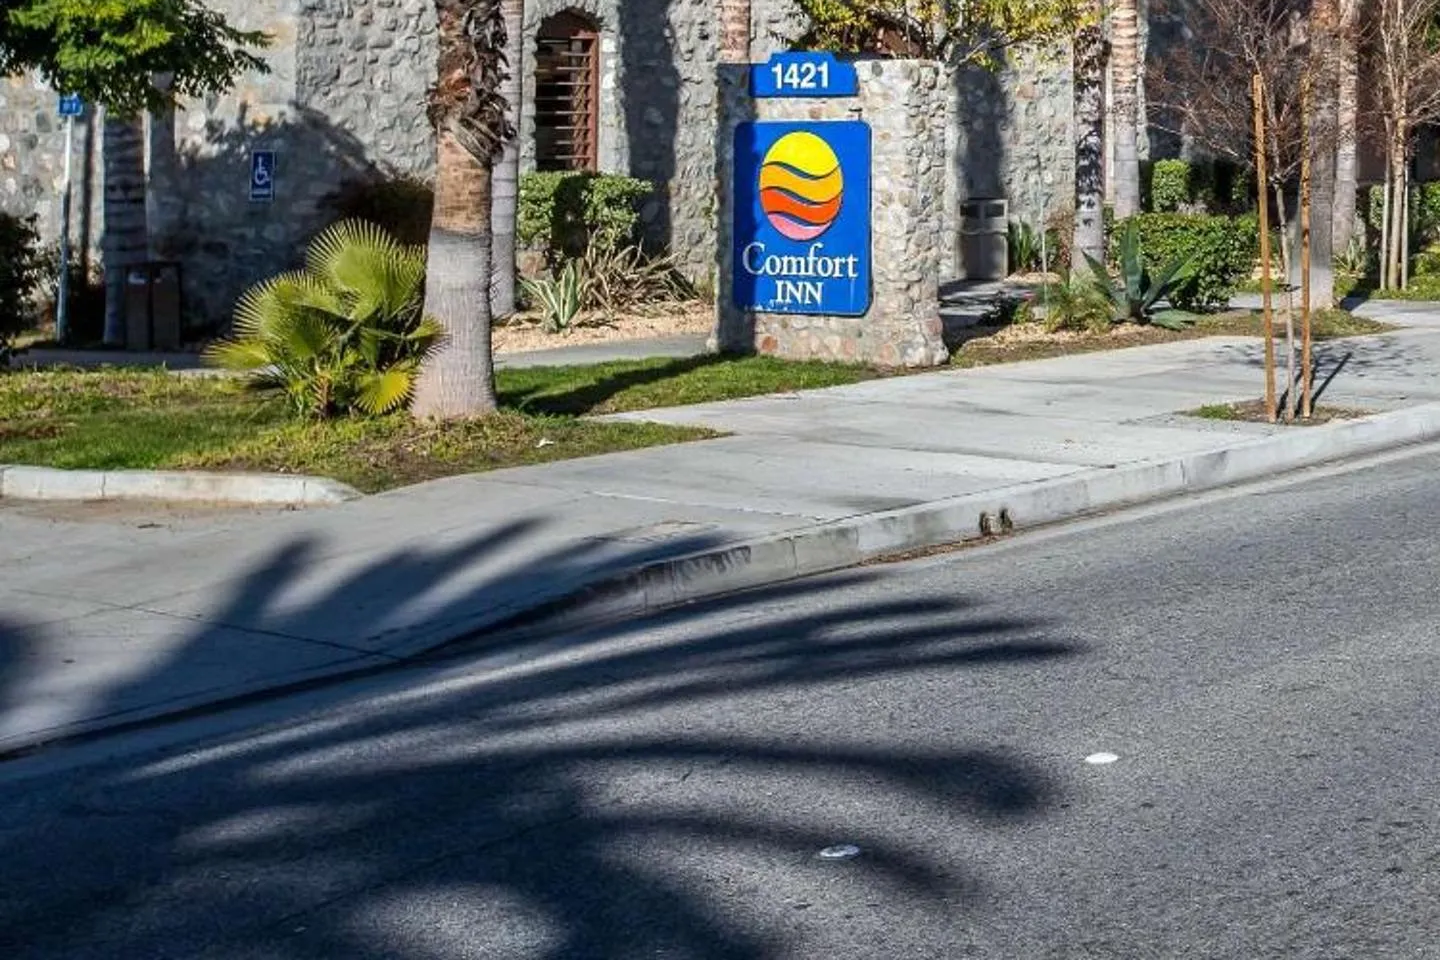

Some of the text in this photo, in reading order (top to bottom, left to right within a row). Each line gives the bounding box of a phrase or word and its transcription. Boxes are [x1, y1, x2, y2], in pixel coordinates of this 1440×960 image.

[771, 61, 829, 89] 1421
[742, 241, 859, 278] Comfort
[775, 280, 824, 305] INN
